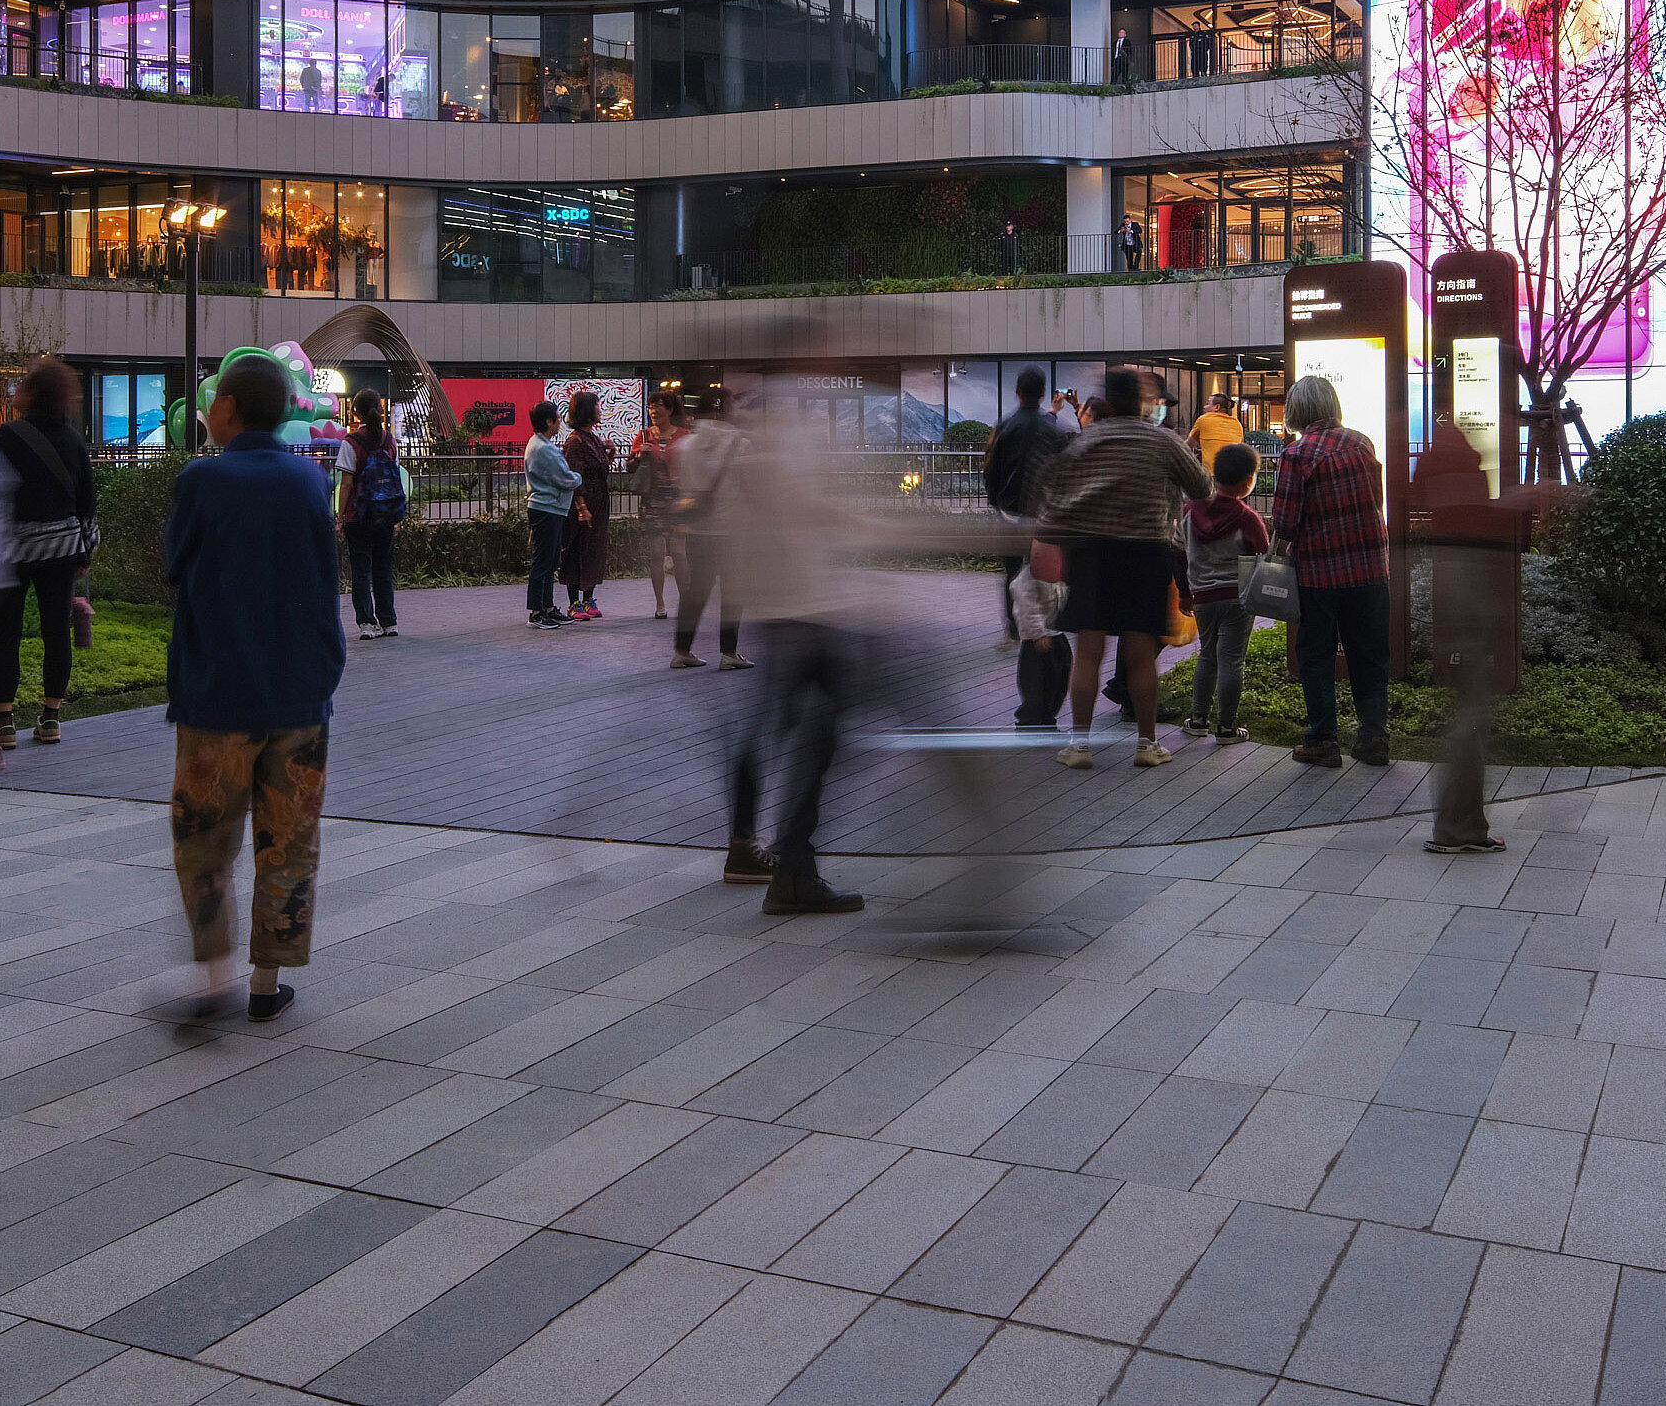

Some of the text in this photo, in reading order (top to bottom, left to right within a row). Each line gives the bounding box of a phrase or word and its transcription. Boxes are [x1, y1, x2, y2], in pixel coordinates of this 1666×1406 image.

[300, 7, 331, 20] DOLL
[1436, 278, 1477, 291] 方向指南
[1436, 293, 1483, 303] DIRECTIONS
[796, 376, 864, 389] DESCENTE
[473, 400, 515, 408] Onitsuka
